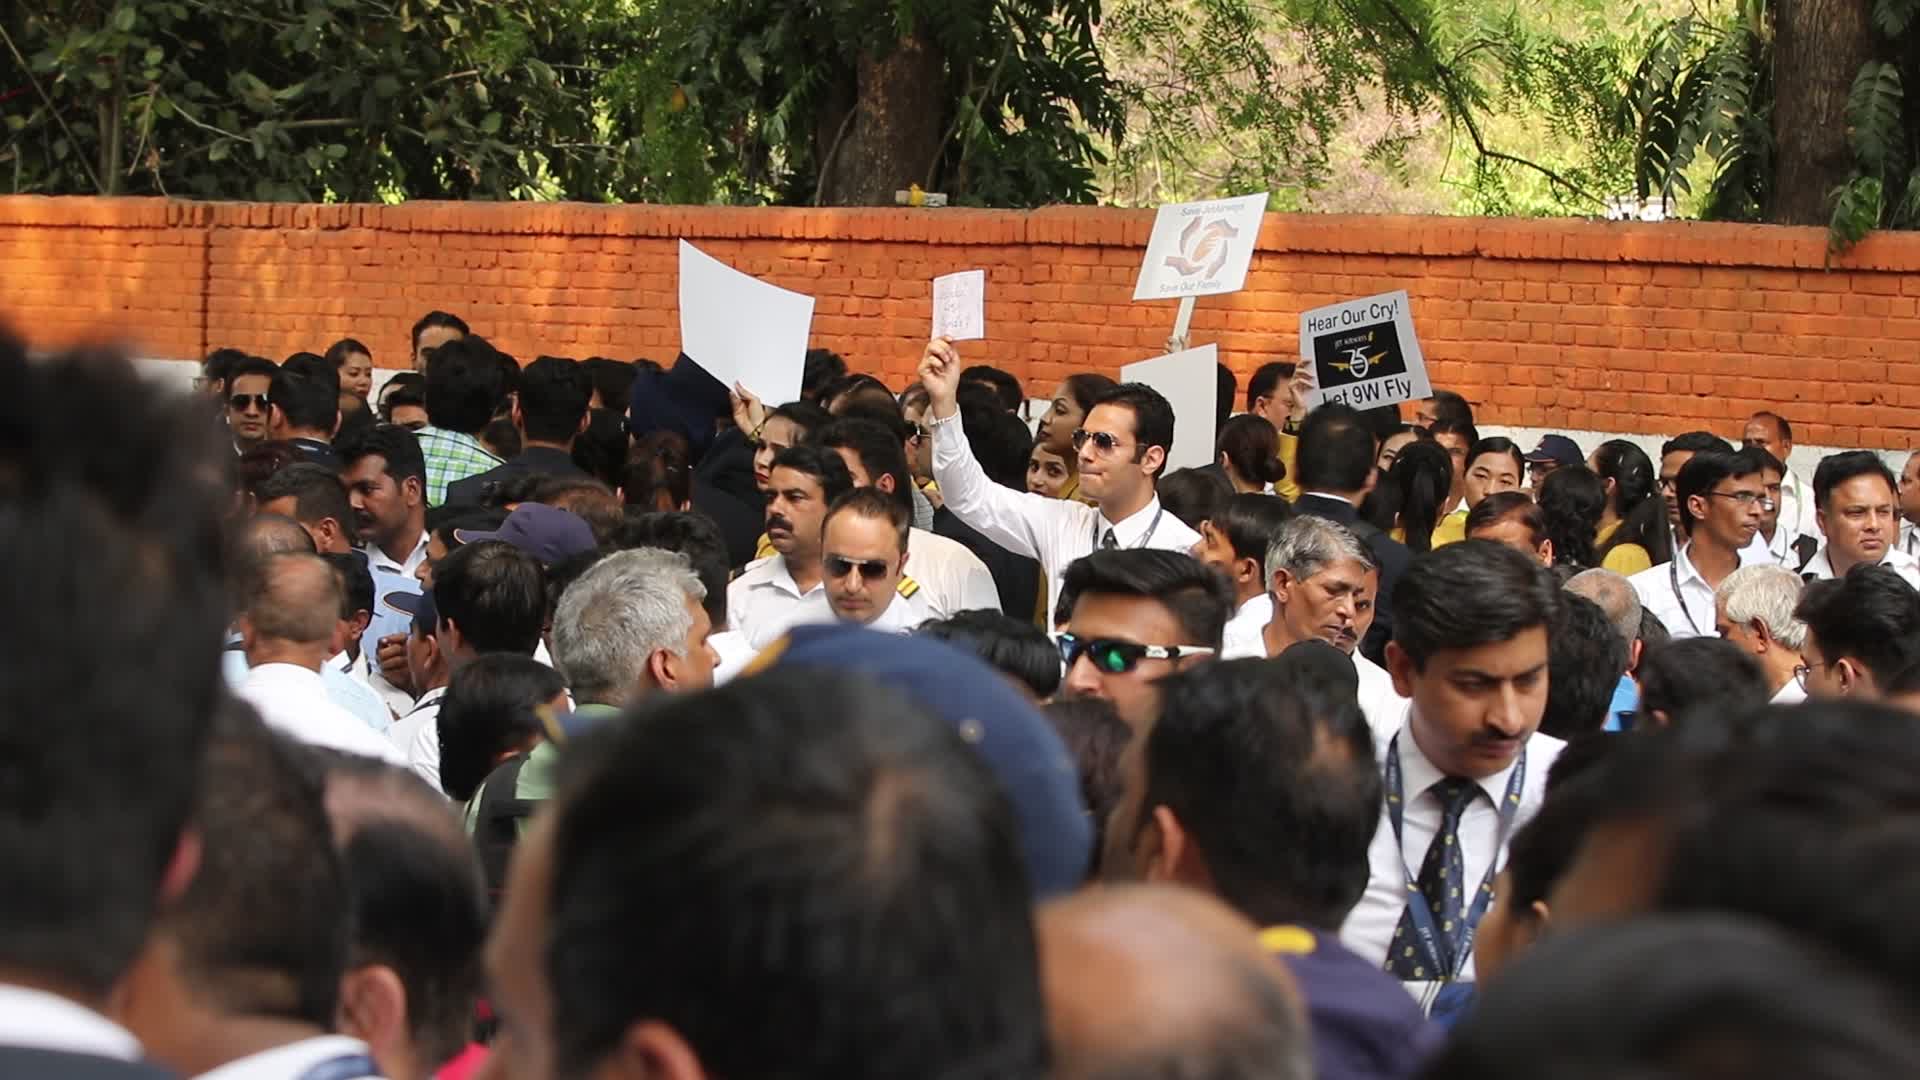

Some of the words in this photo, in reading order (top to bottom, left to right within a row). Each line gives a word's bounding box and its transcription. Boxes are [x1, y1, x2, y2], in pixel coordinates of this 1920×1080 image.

[1160, 283, 1178, 292] Save
[1180, 281, 1196, 291] Our
[1308, 316, 1338, 332] Hear
[1341, 309, 1366, 325] Our
[1369, 299, 1399, 320] Cry!
[1352, 382, 1379, 404] 9W
[1384, 378, 1411, 399] Fly
